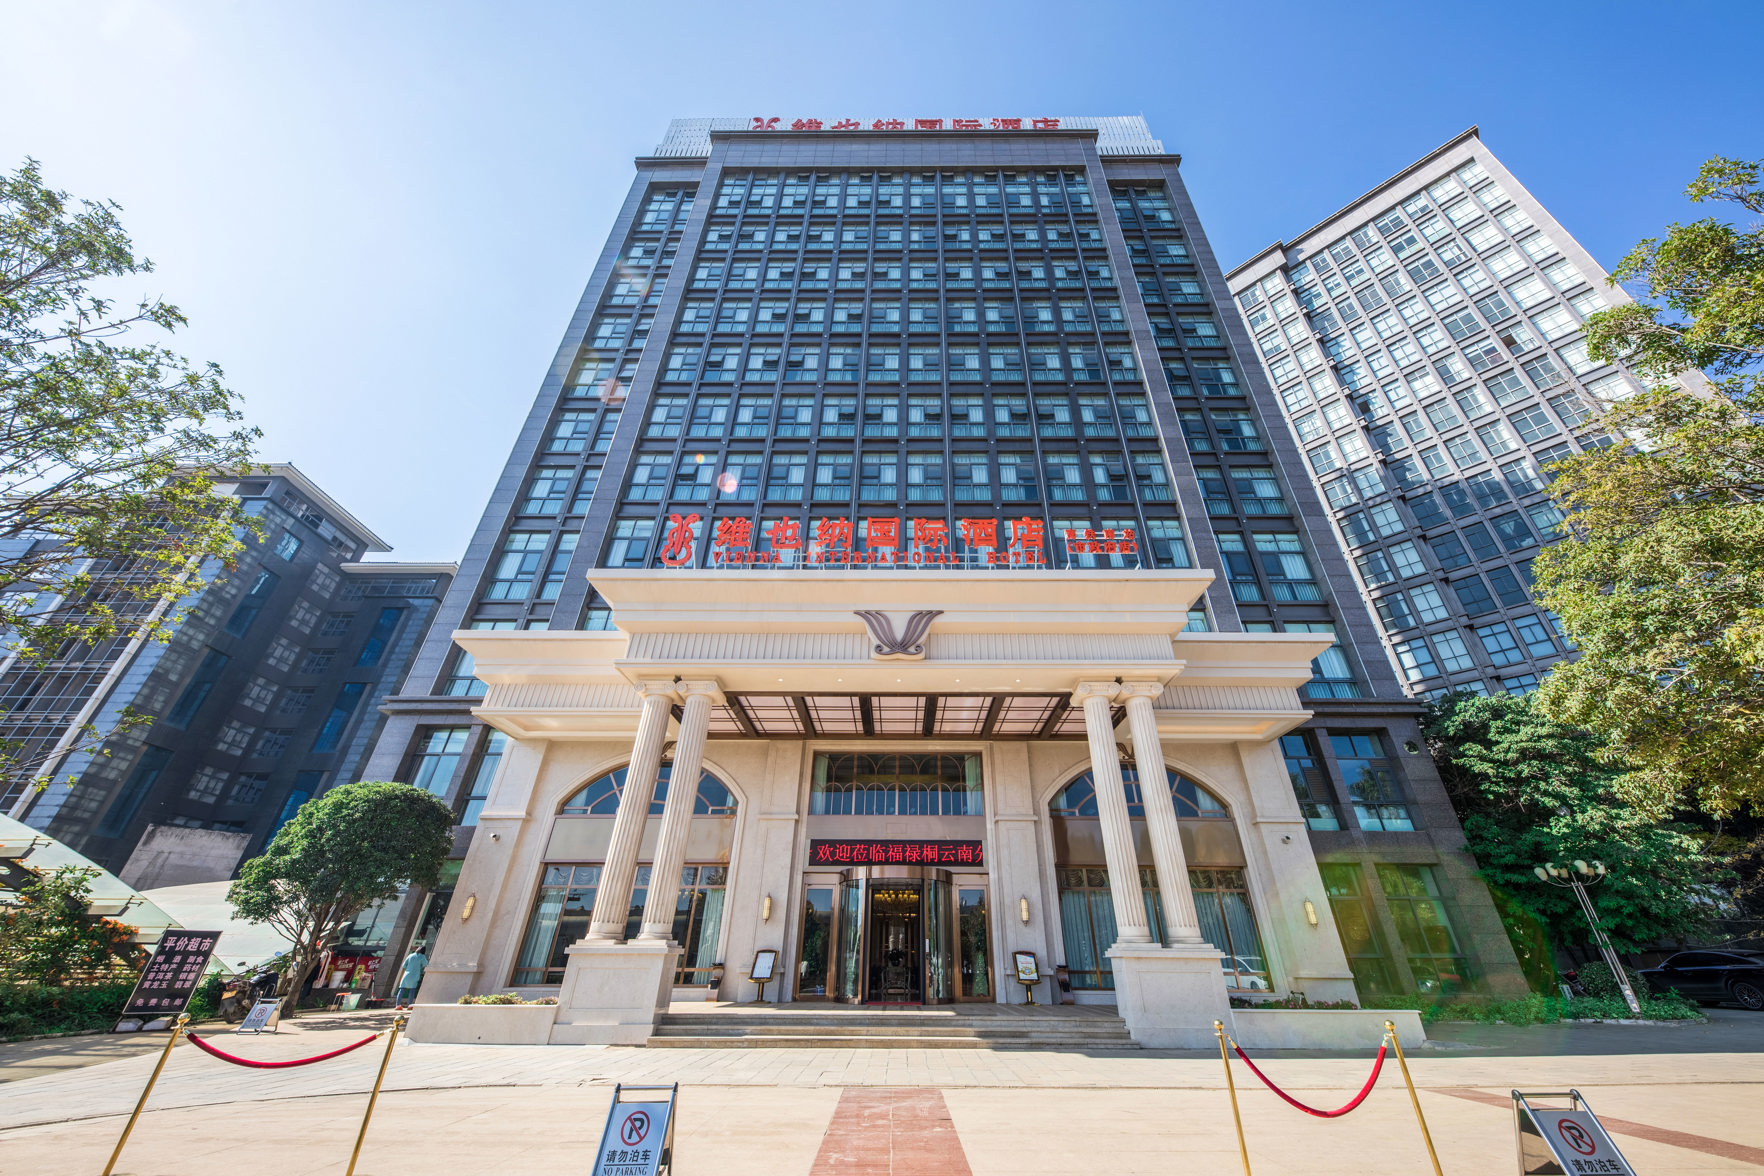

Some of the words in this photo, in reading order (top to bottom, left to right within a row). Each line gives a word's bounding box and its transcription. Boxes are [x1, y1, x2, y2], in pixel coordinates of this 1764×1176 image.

[714, 516, 1044, 549] 维也纳国际酒店
[713, 551, 782, 564] VIENNA
[805, 551, 960, 564] INTERNATIONAL
[987, 551, 1047, 564] HOTEL
[164, 936, 213, 951] 平价超市
[150, 963, 178, 971] 土特产
[147, 972, 173, 980] 普洱茶
[142, 981, 169, 989] 黄龙玉
[605, 1149, 651, 1163] 请勿泊车
[603, 1167, 613, 1176] NO
[615, 1166, 648, 1176] PARKING
[1571, 1158, 1621, 1173] 请勿泊车
